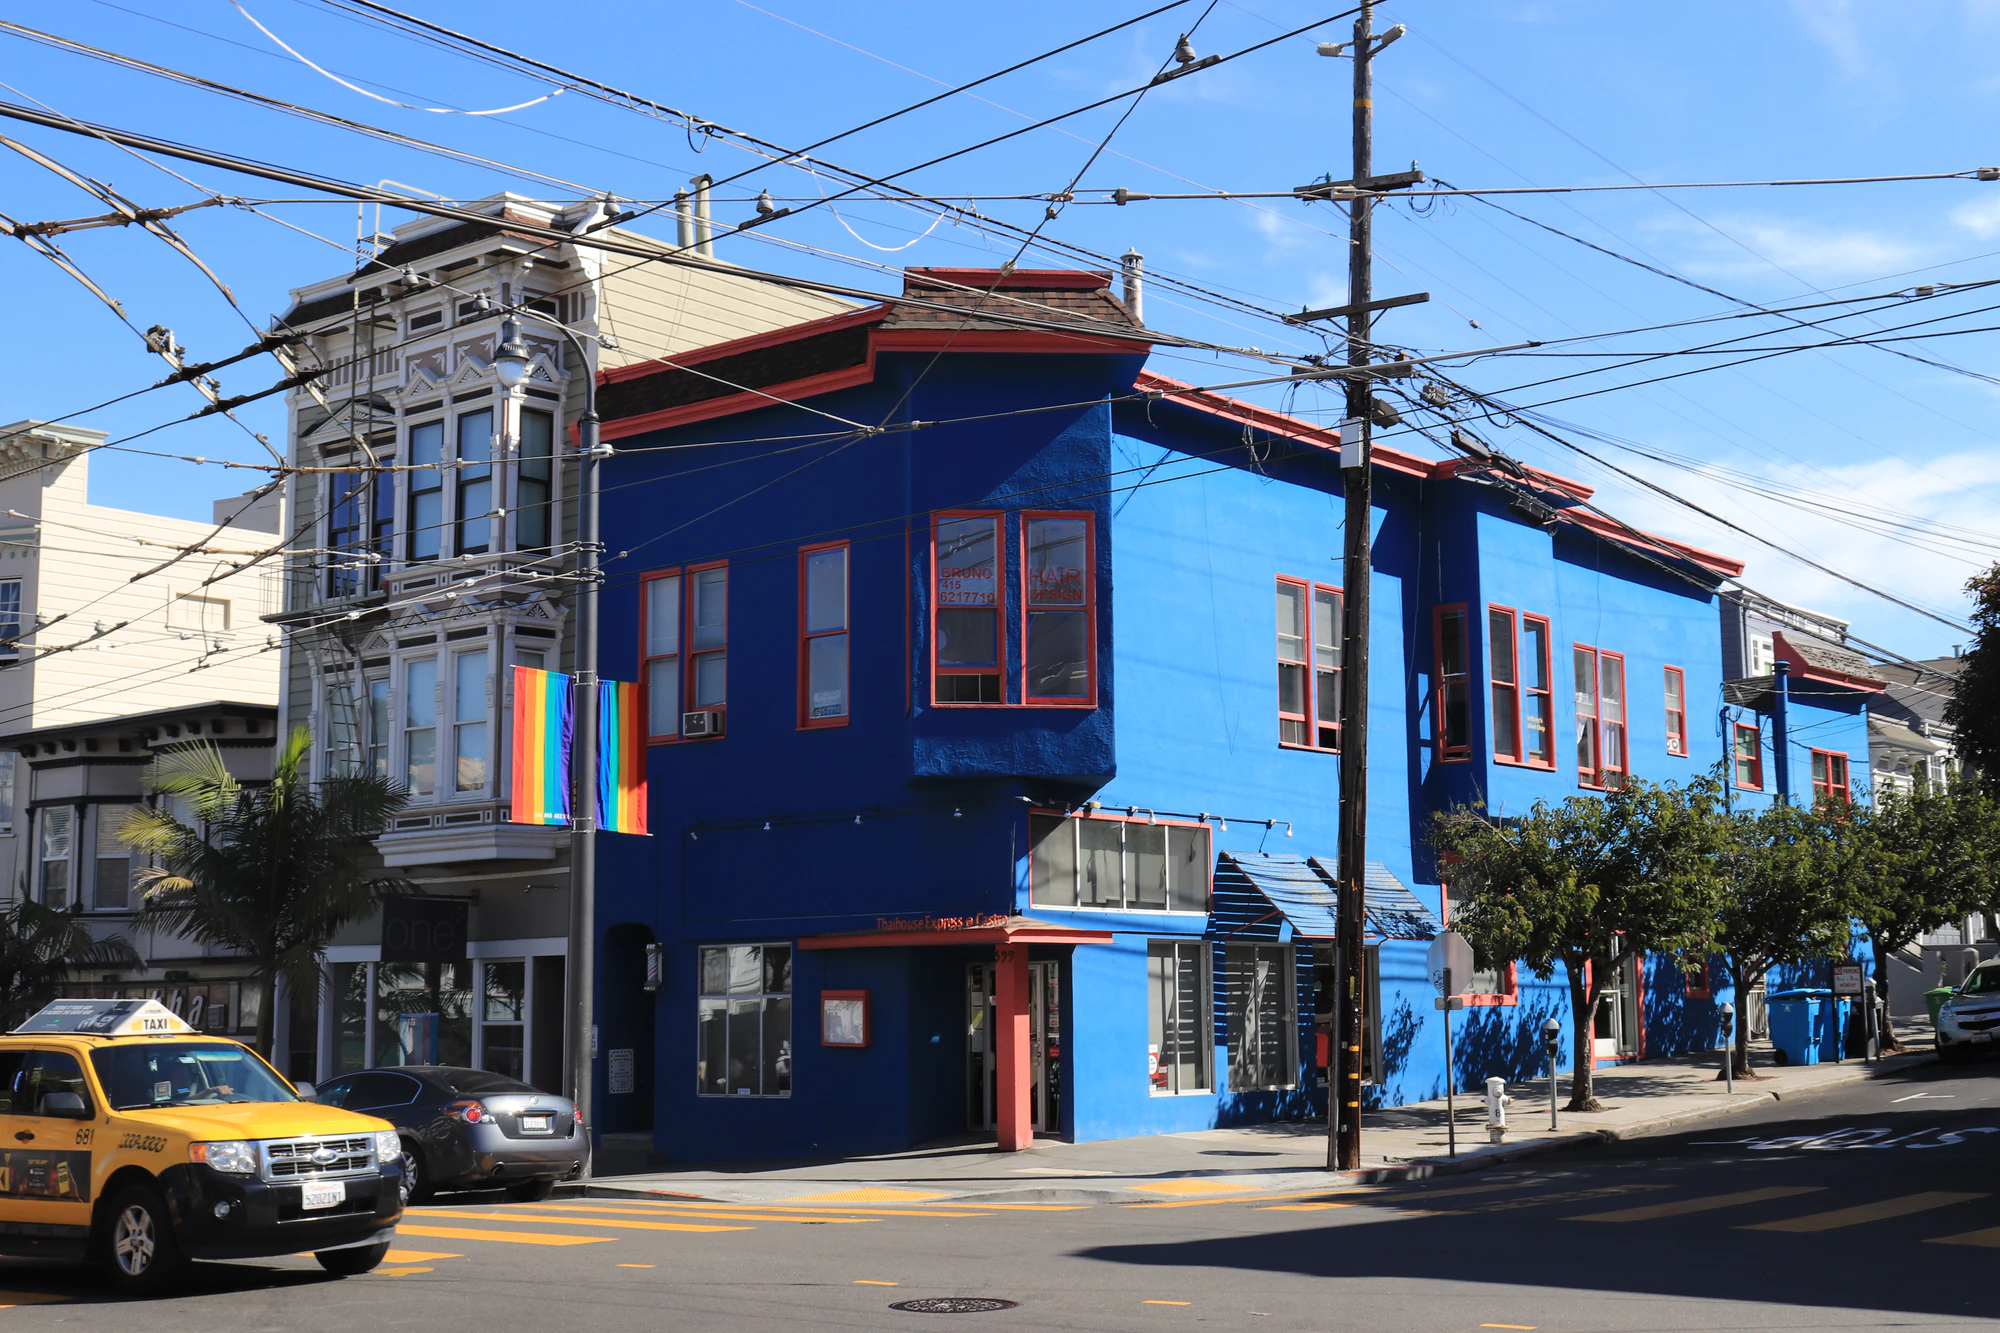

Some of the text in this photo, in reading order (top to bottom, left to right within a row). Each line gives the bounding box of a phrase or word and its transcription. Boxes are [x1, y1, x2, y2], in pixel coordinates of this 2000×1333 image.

[941, 567, 993, 579] BRUNO
[1029, 568, 1081, 585] HAIR
[942, 580, 961, 589] 415
[940, 591, 995, 603] 6217710
[1029, 589, 1083, 600] DESIGN
[877, 917, 924, 931] Thaihouse
[925, 915, 963, 931] Express
[976, 912, 1009, 927] Castro
[385, 918, 456, 951] one
[143, 1018, 168, 1031] TAXI
[75, 1128, 95, 1145] 681
